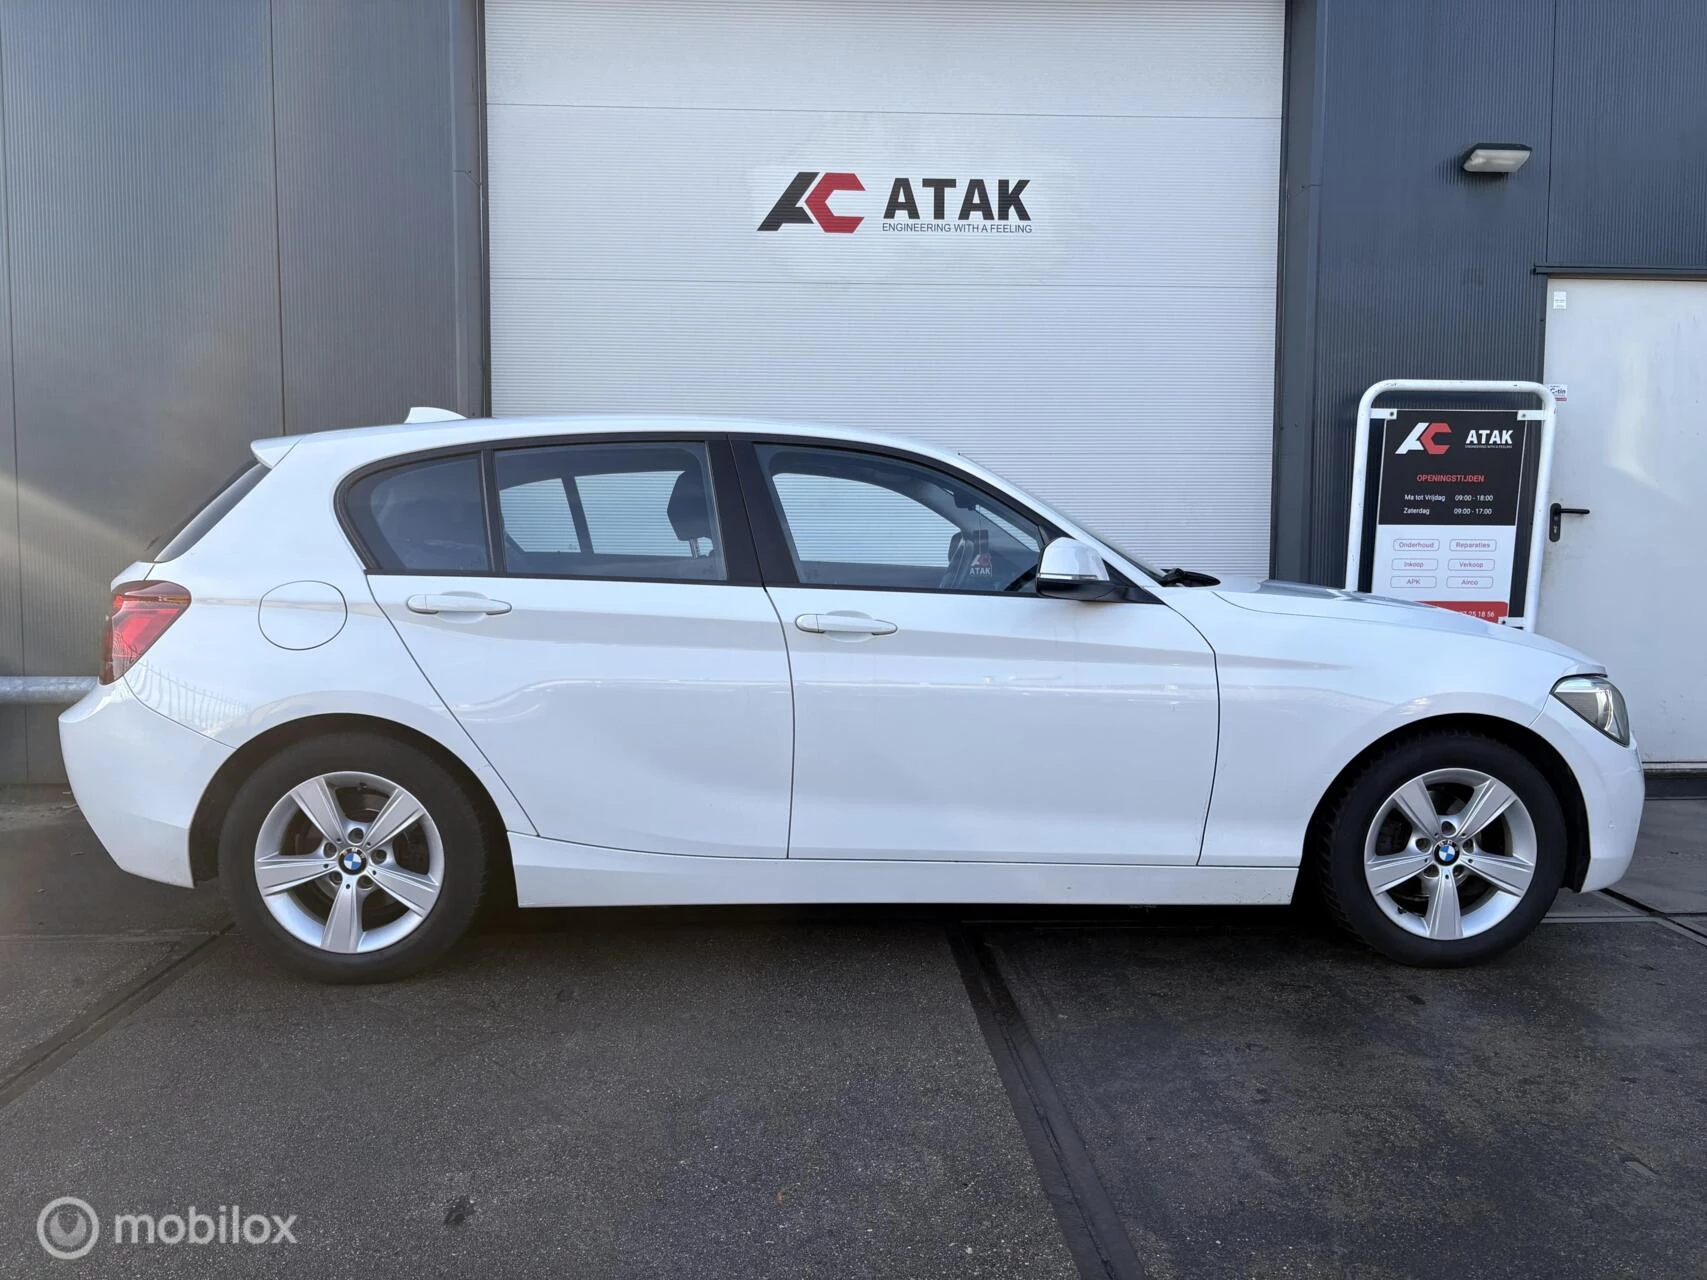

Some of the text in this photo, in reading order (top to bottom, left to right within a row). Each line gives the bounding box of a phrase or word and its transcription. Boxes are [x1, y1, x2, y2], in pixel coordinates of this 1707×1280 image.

[883, 178, 1032, 221] ATAK
[882, 223, 1033, 233] ENGINEERING WITH A FEELING
[1465, 429, 1513, 444] ATAK
[1416, 474, 1485, 482] OPENINGSTIJDEN
[1425, 494, 1446, 502] Vrijdag
[1403, 507, 1430, 515] Zaterdag
[1453, 507, 1471, 515] 09:00
[1475, 507, 1493, 515] 17:00
[1455, 541, 1490, 549] Reparaties
[1459, 561, 1484, 569] Verkoop
[969, 567, 991, 576] ATAK
